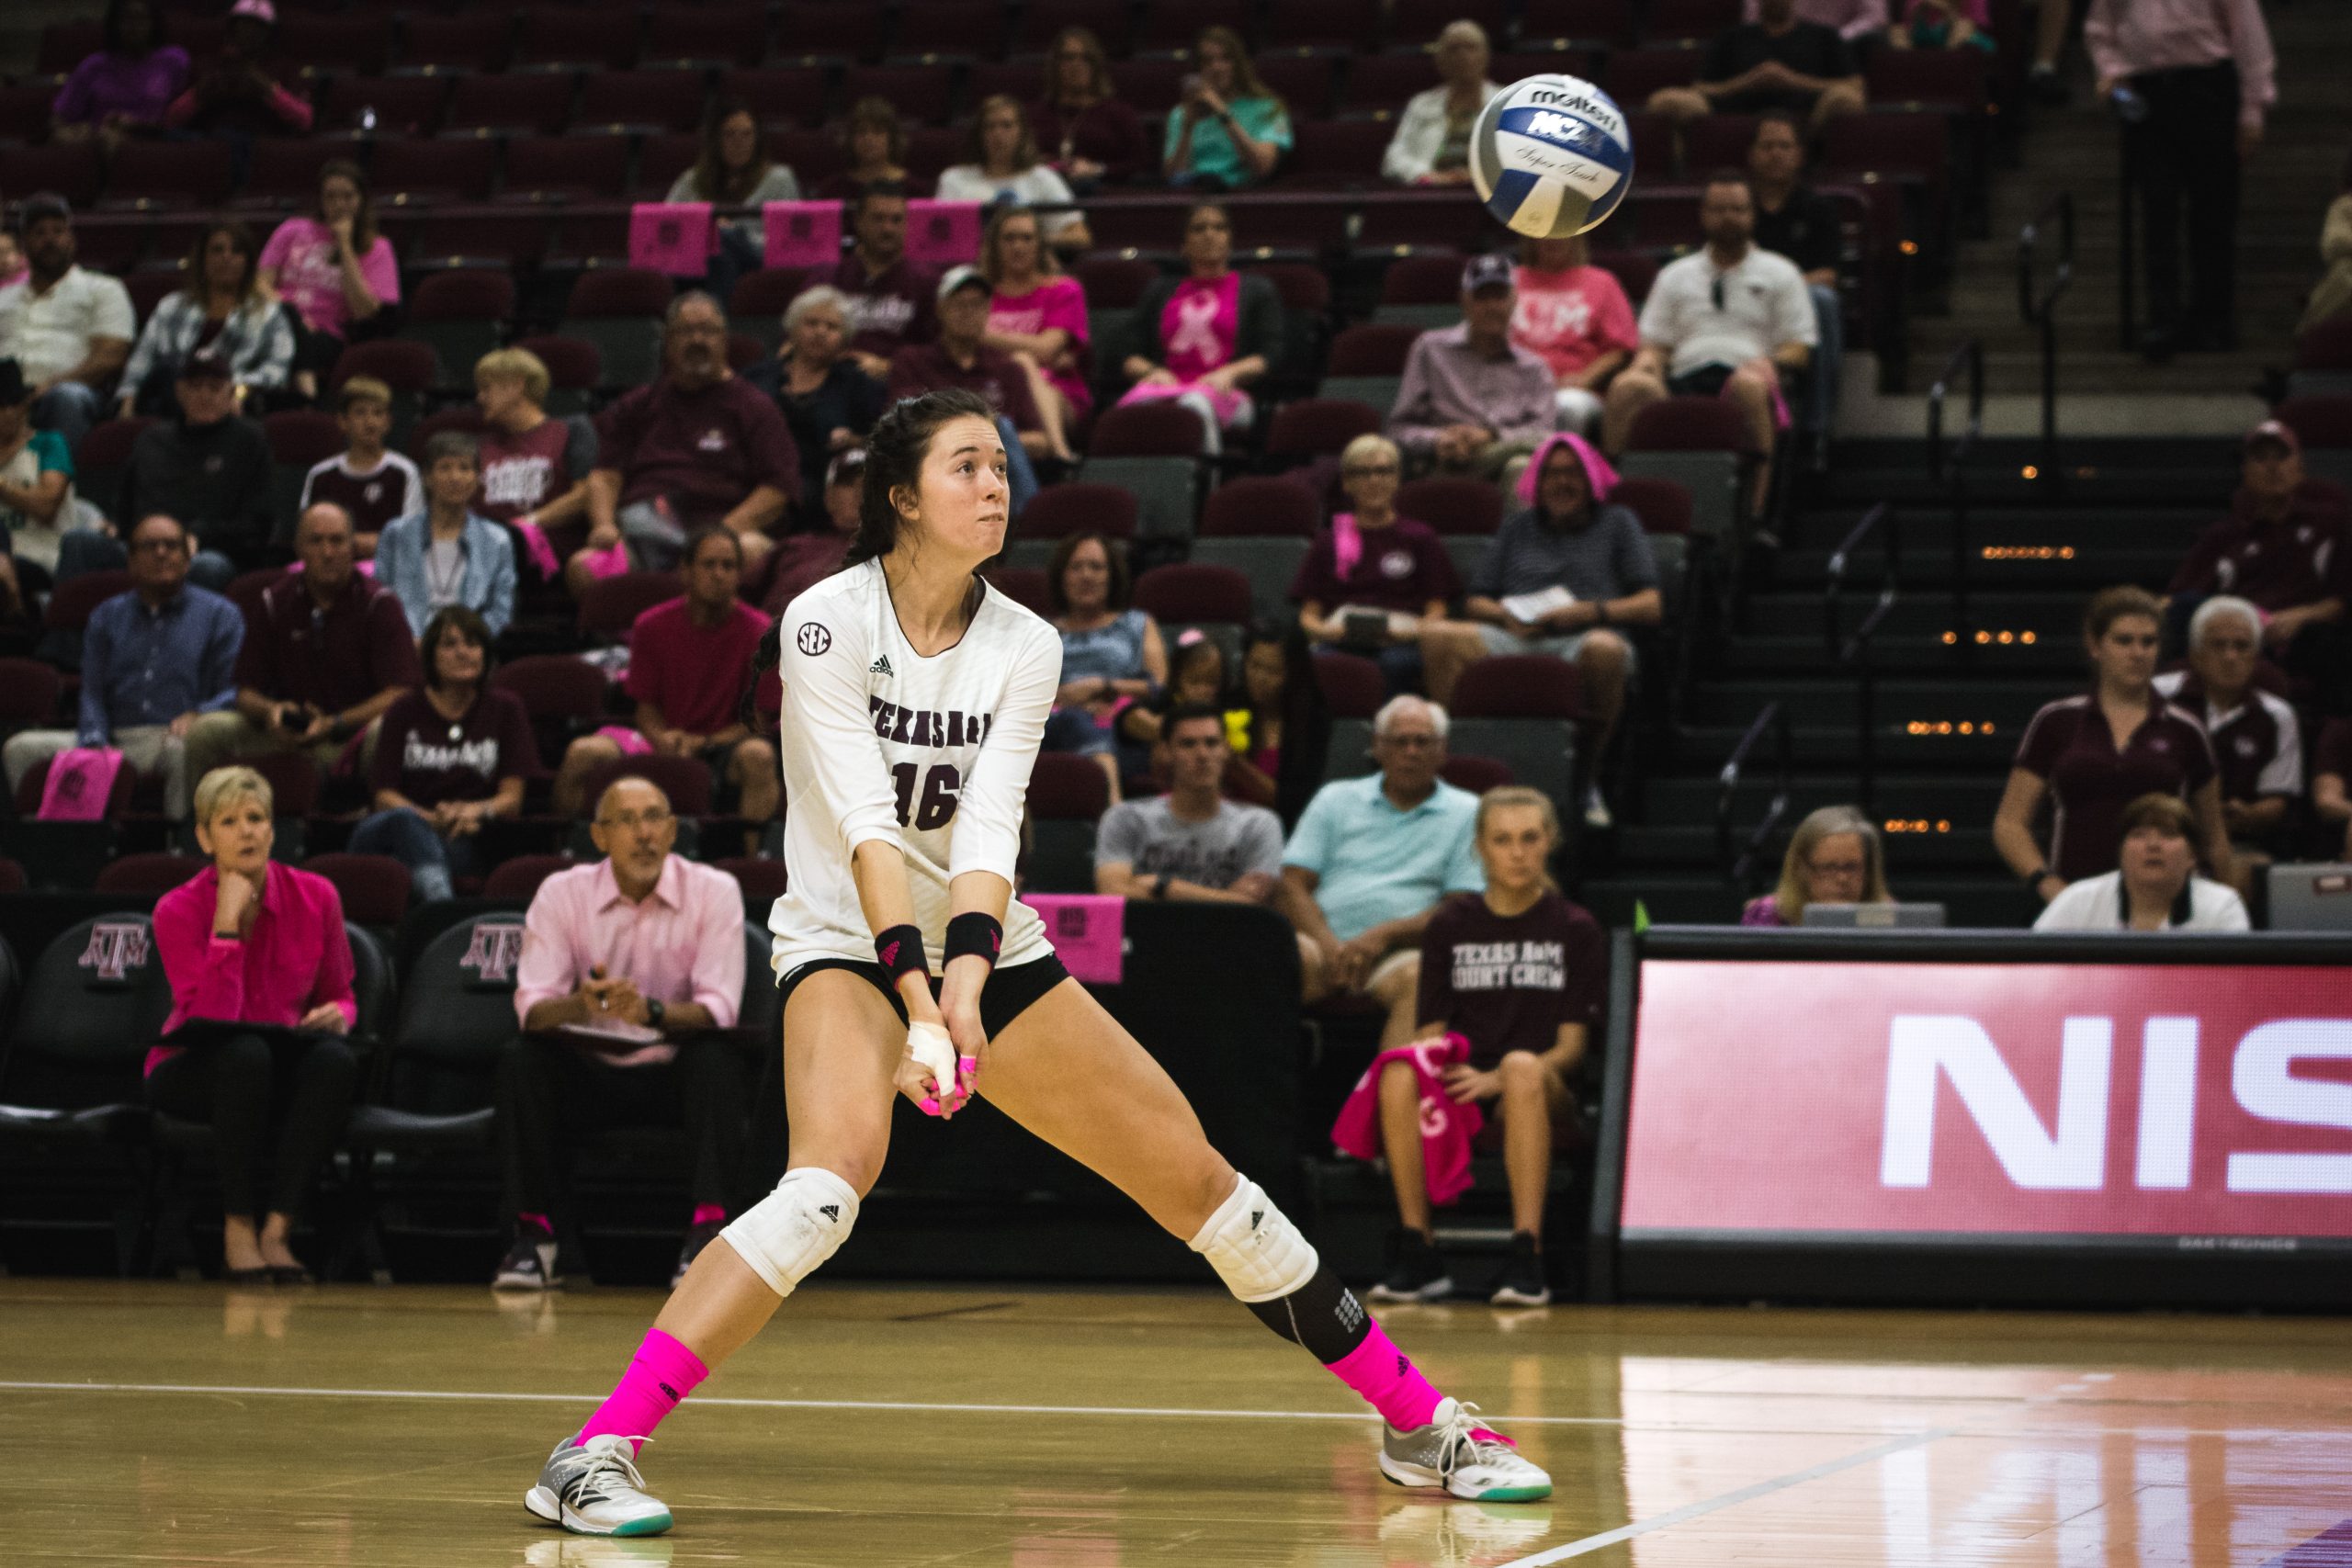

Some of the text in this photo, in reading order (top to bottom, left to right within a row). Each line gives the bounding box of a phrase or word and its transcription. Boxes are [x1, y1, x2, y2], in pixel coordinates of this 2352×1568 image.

[1530, 90, 1618, 131] molten
[797, 623, 831, 655] SEC
[868, 694, 945, 749] TEXAS
[891, 761, 961, 832] 16
